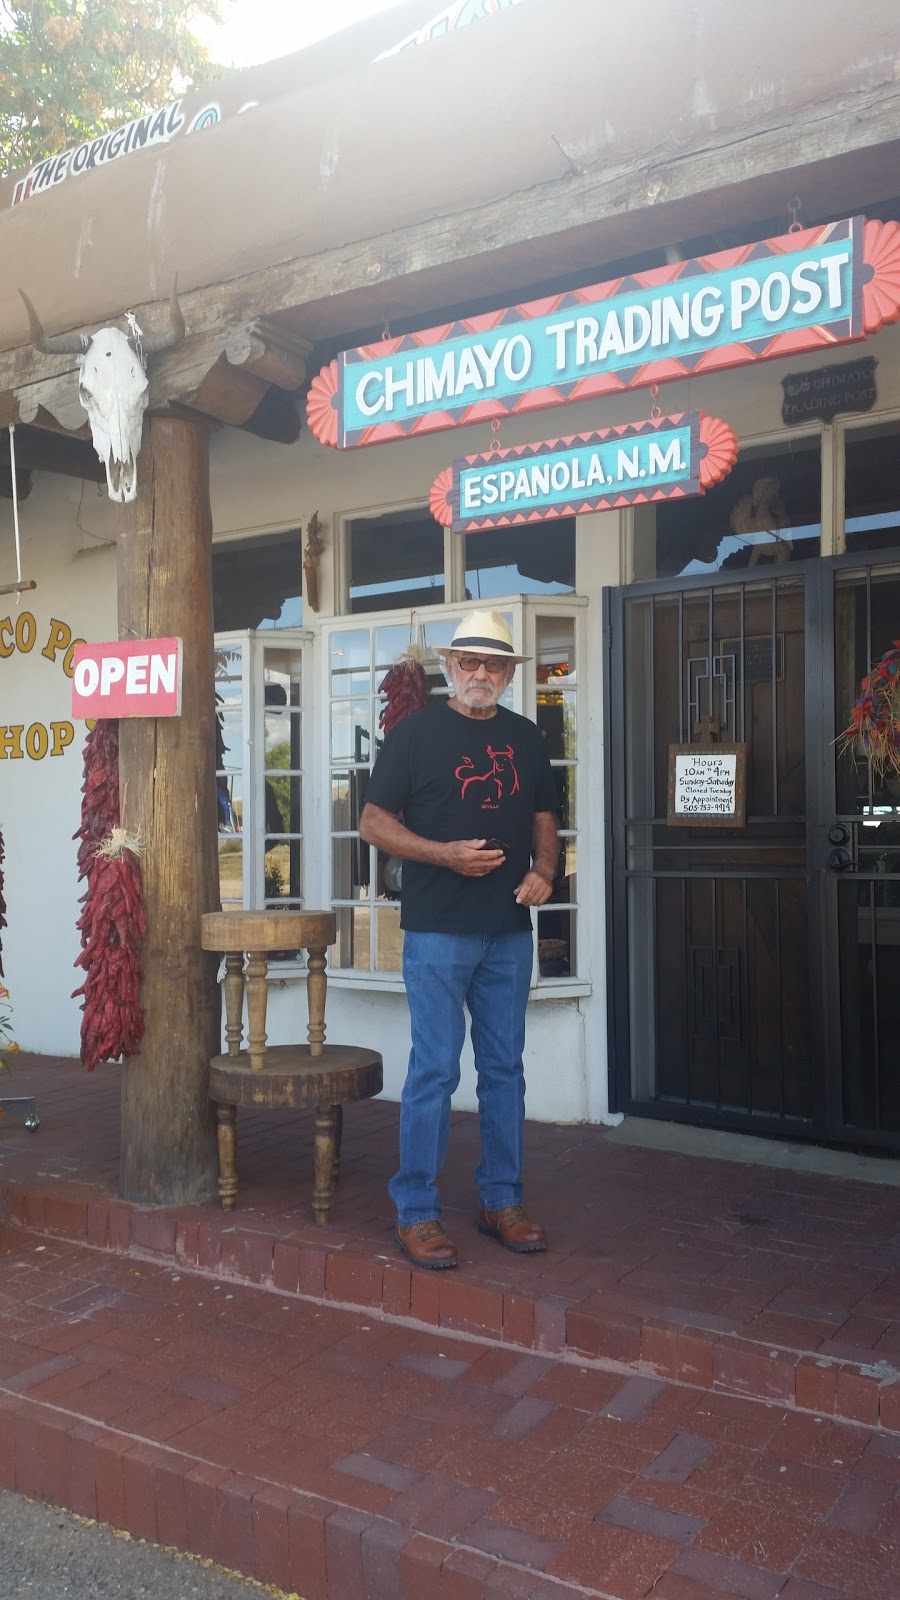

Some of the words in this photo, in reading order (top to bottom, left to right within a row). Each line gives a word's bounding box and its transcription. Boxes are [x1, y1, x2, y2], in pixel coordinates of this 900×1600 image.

[32, 152, 71, 191] THE
[72, 102, 182, 172] ORIGINAL
[355, 335, 532, 417] CHIMAYO
[546, 286, 725, 371] TRADING
[730, 252, 850, 331] POST
[784, 396, 841, 415] TRADING
[844, 390, 873, 404] POST
[463, 452, 614, 509] ESPANOLA,
[617, 437, 688, 481] N.M.
[74, 653, 177, 698] OPEN
[692, 758, 723, 766] Hours
[680, 795, 690, 804] By
[691, 795, 733, 804] Appointment
[709, 787, 732, 797] Tuesday
